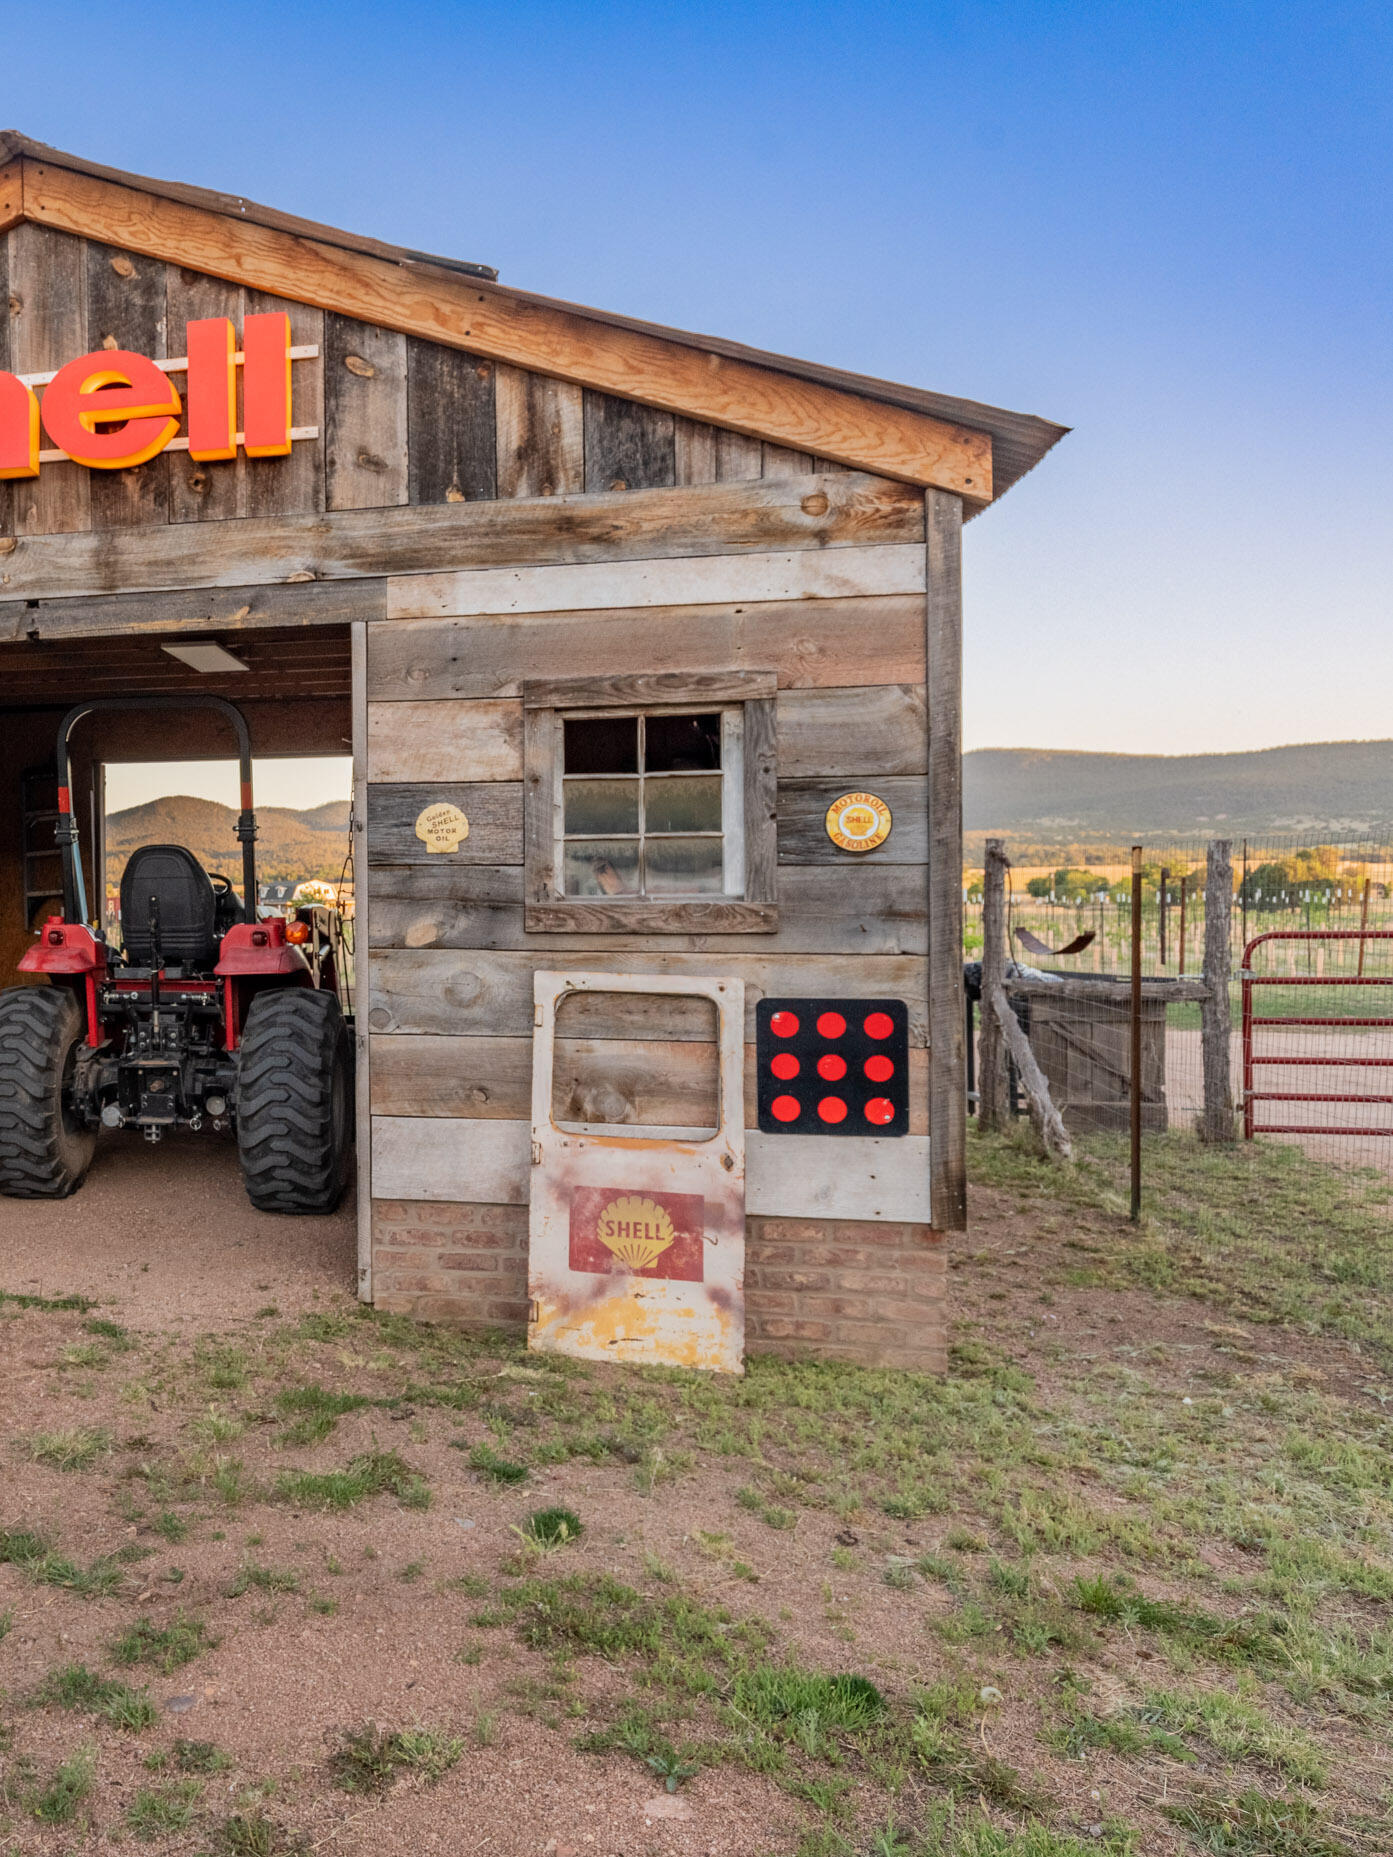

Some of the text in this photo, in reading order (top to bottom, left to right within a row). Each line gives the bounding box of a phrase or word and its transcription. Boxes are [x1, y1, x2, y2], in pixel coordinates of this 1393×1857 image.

[432, 815, 459, 828] SHELL
[845, 815, 873, 824] SHELL
[605, 1219, 666, 1241] SHELL
